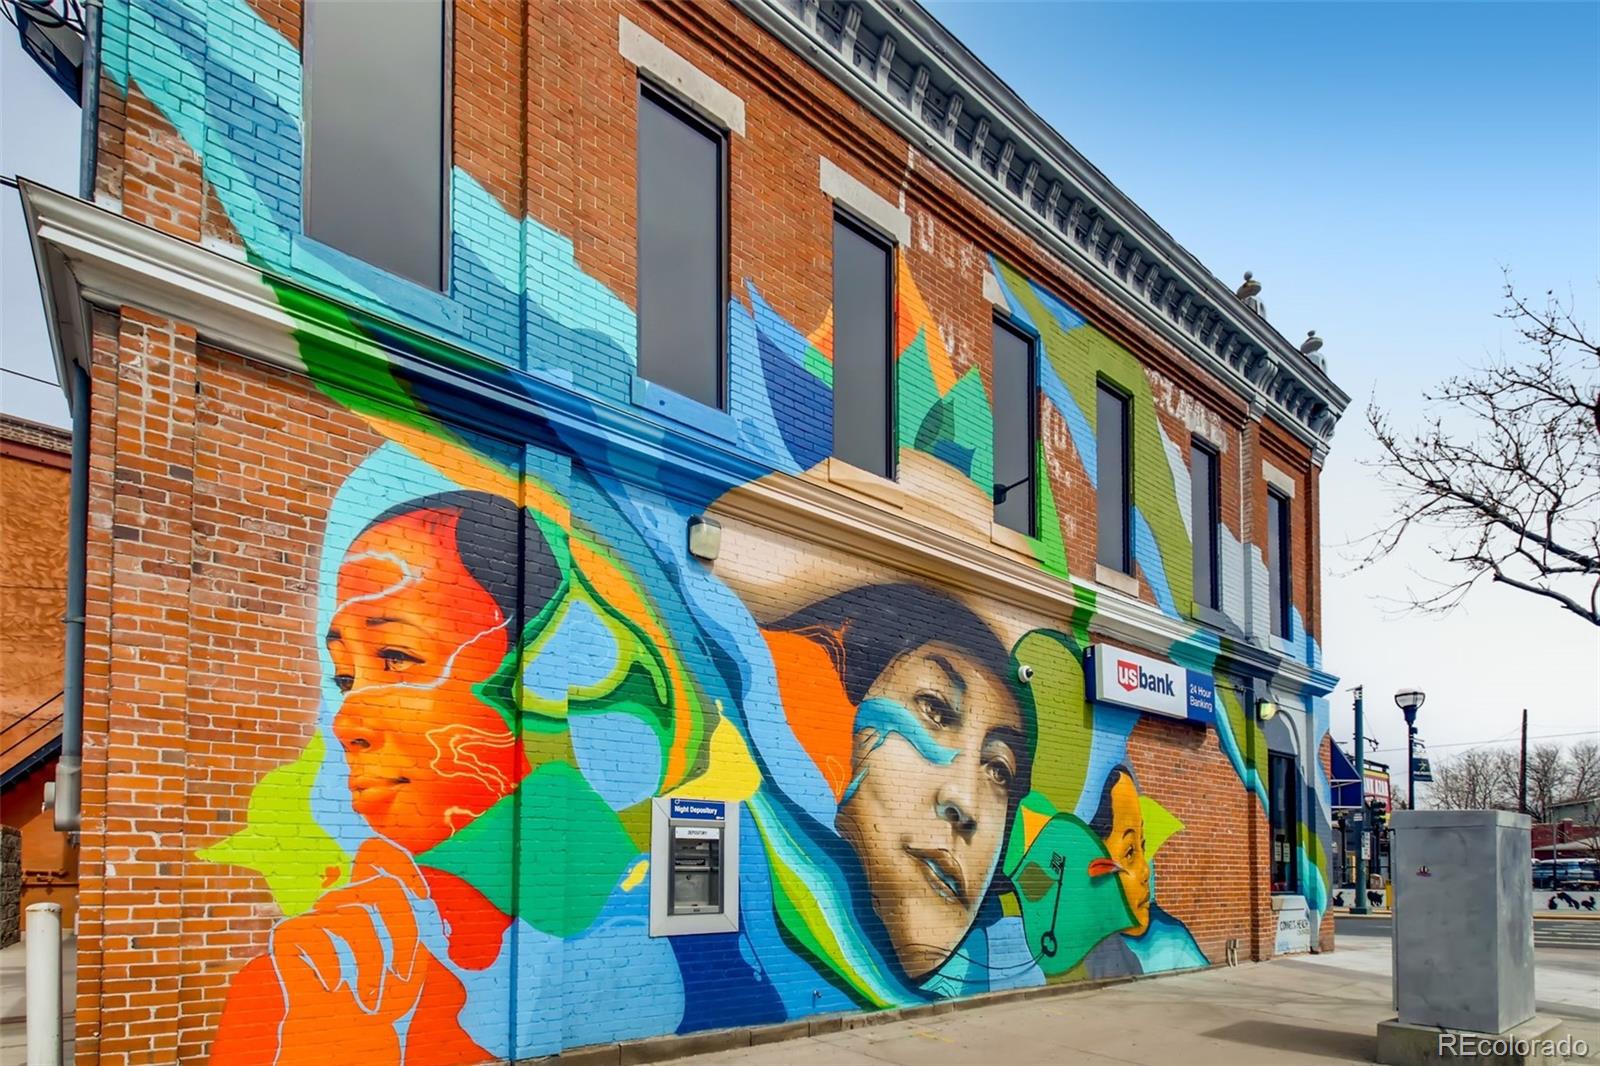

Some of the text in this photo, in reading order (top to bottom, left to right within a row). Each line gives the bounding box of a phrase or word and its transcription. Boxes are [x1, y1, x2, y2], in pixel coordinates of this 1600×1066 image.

[1190, 684, 1212, 699] 24 Hour
[1190, 696, 1213, 713] Banking
[674, 805, 718, 816] Night Depository
